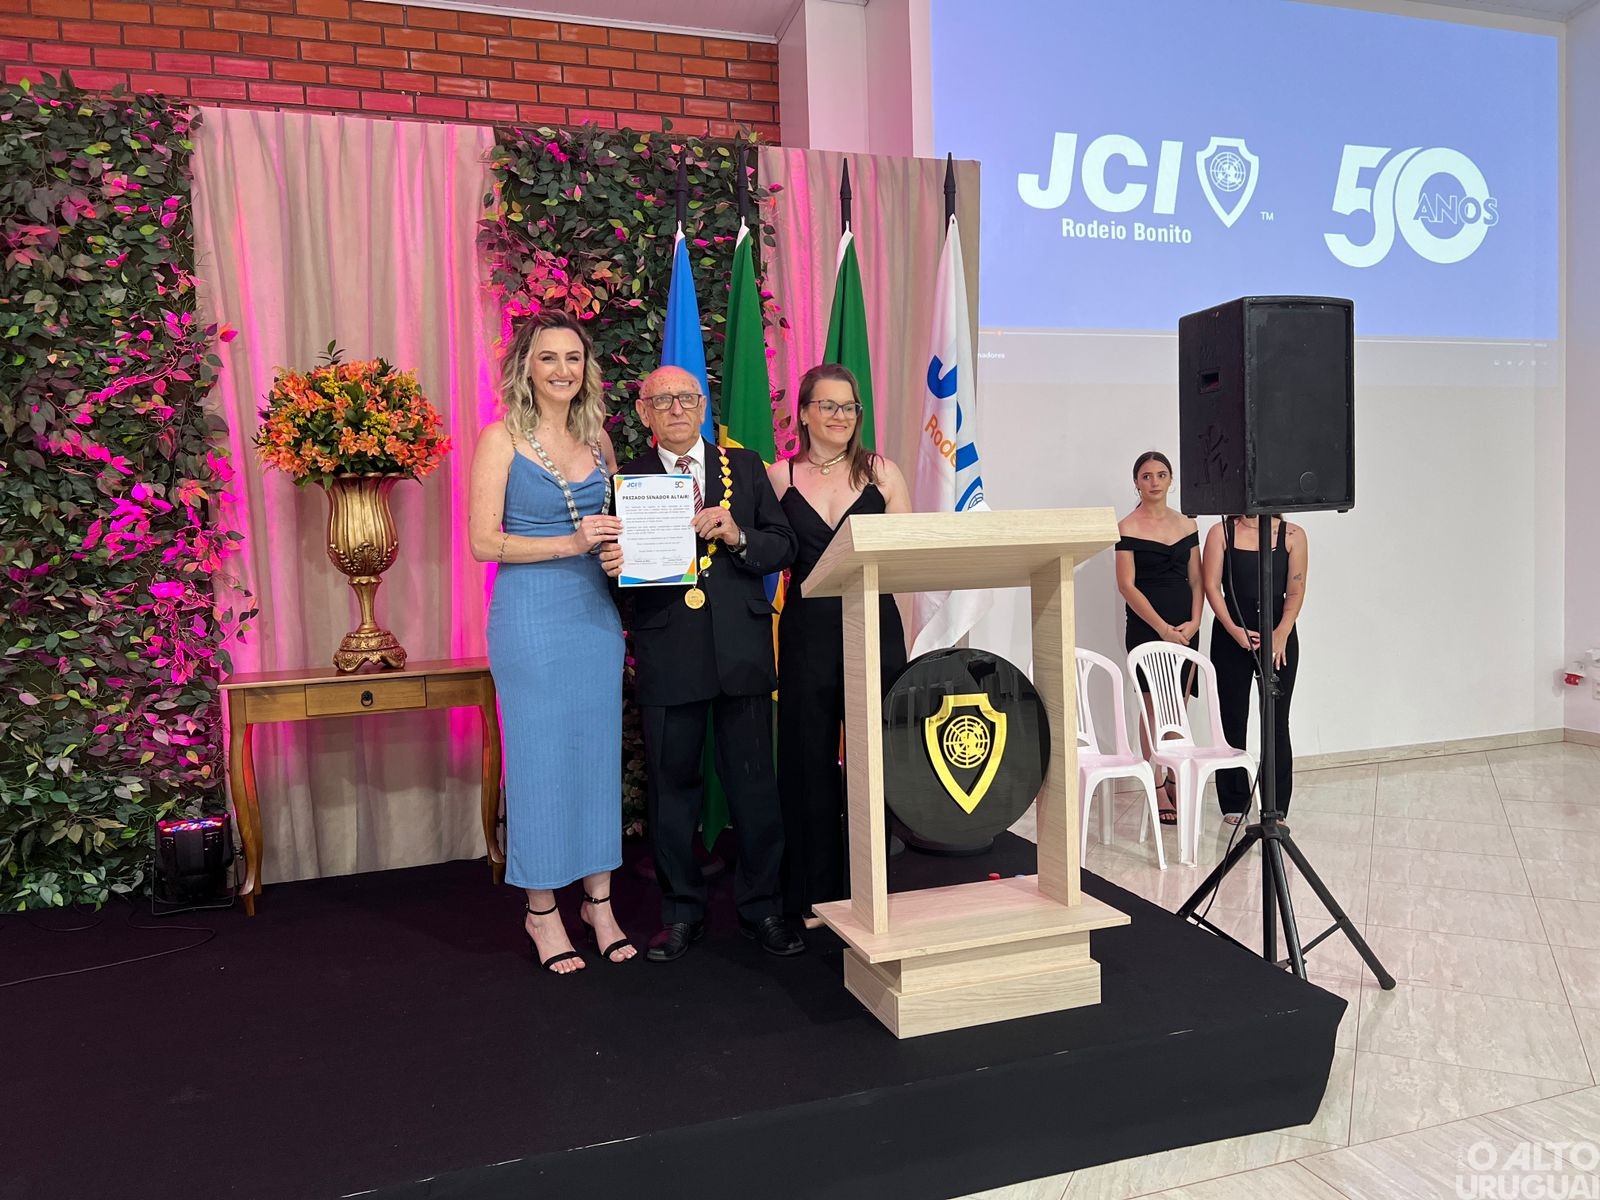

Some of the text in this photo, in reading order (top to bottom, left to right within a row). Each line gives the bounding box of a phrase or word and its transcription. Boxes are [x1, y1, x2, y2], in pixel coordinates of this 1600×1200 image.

[1017, 131, 1184, 215] JCI
[1260, 211, 1274, 221] TM
[1323, 144, 1490, 268] 50
[1412, 192, 1500, 227] ANOS
[1061, 217, 1193, 244] Rodeio Bonito
